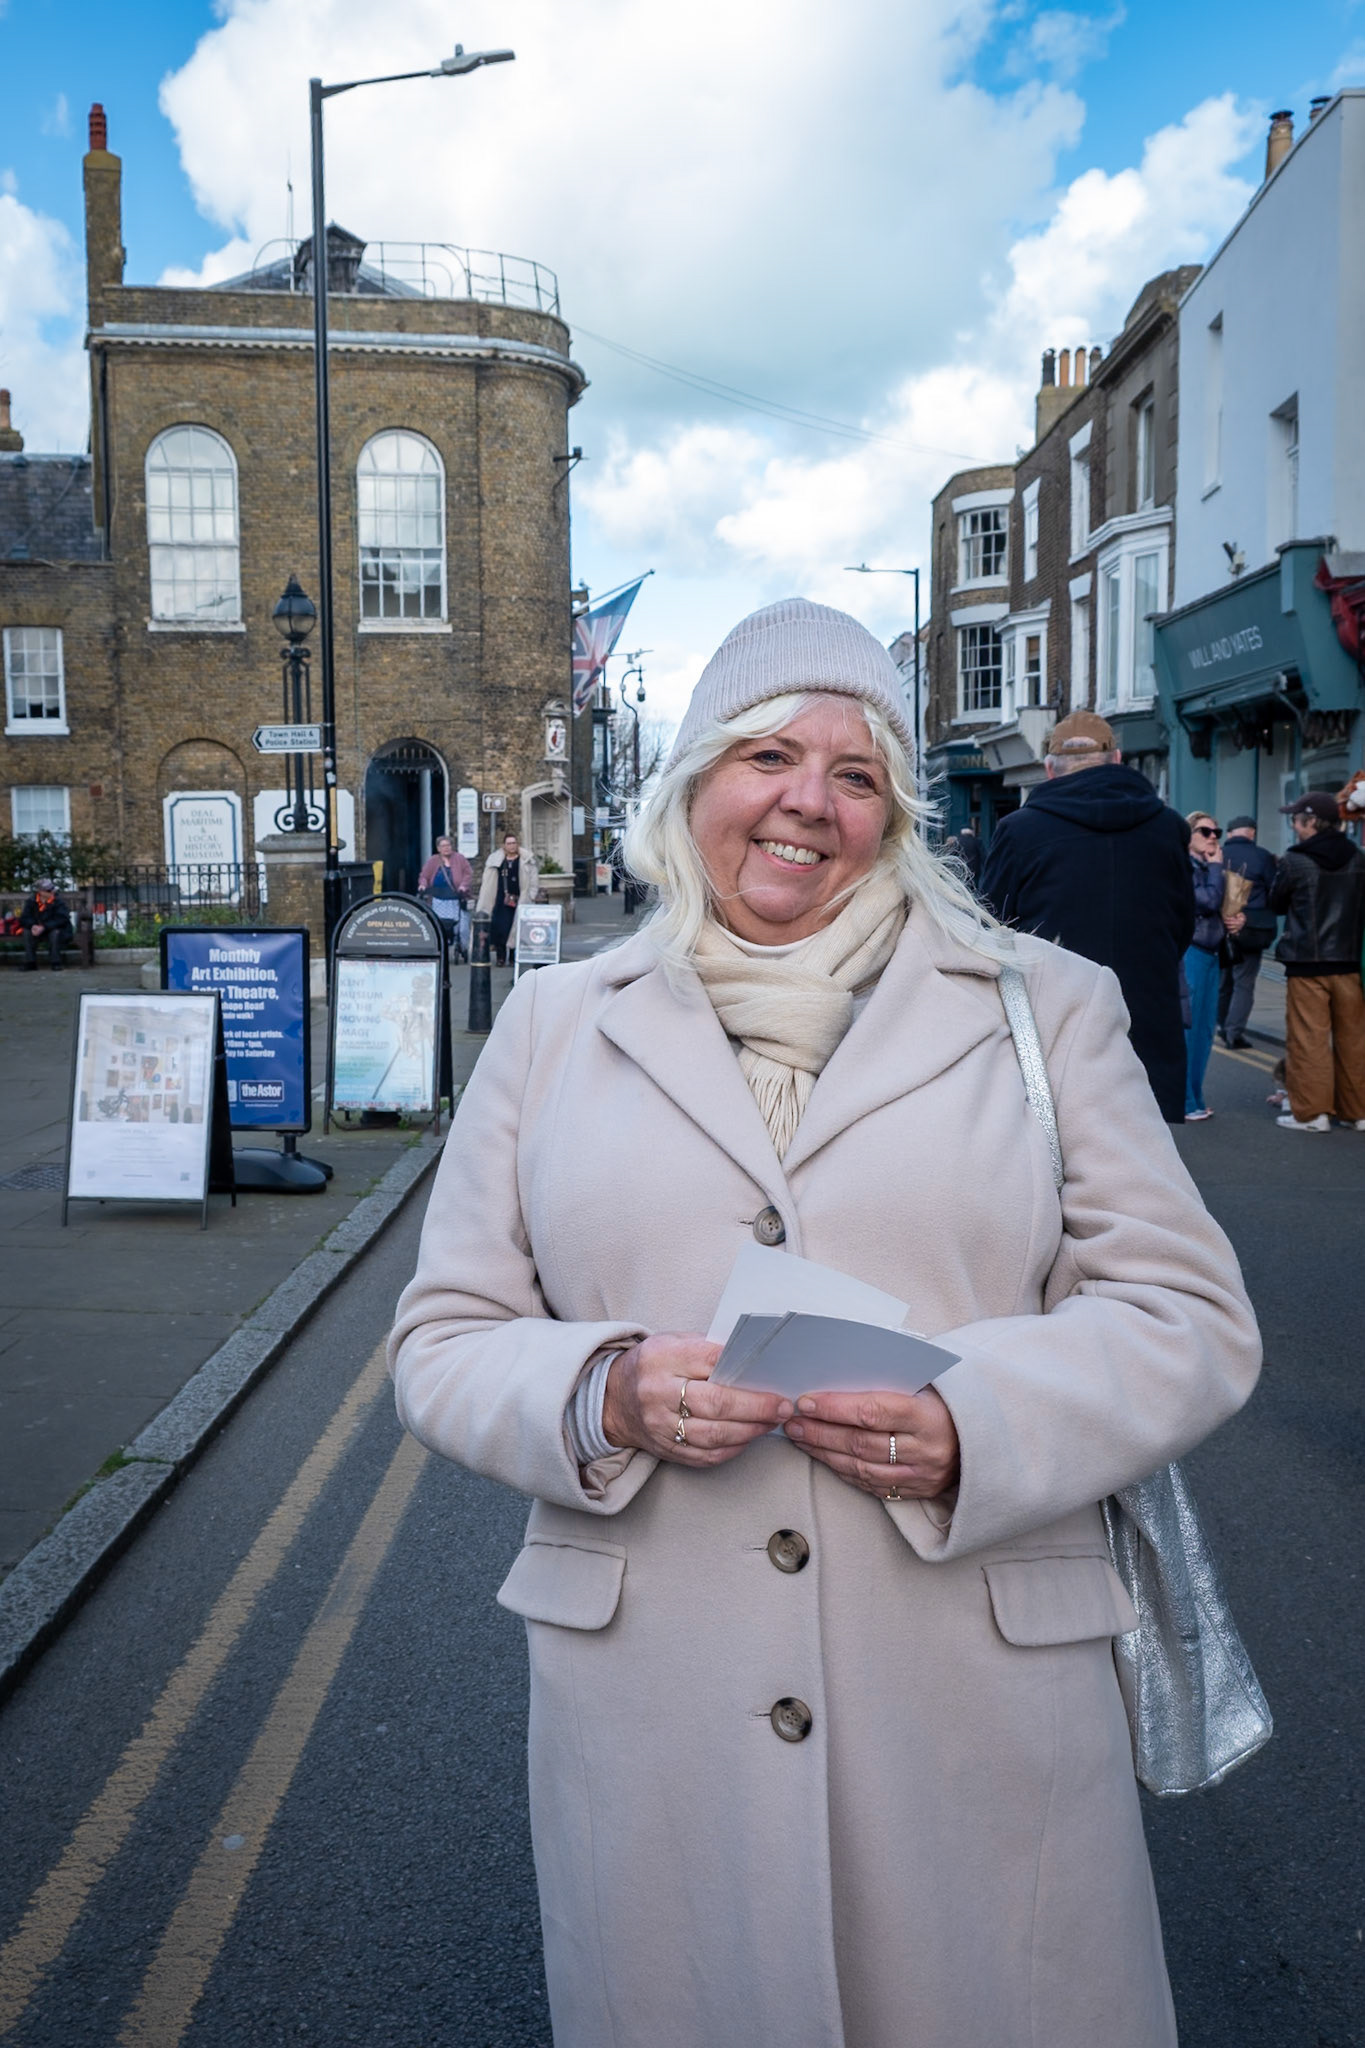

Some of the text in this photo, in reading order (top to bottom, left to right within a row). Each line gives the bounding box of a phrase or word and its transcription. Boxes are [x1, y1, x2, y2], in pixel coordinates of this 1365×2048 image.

[1188, 625, 1263, 669] WILL AND YATES
[265, 739, 288, 747] Police
[191, 809, 215, 818] DEAL
[180, 817, 224, 826] MARITIME
[188, 834, 217, 842] LOCAL
[185, 843, 222, 851] HISTORY
[183, 851, 224, 859] MUSEUM
[356, 908, 379, 925] MUSEUM
[378, 905, 388, 913] OF
[387, 905, 400, 913] THE
[399, 908, 422, 926] MOVING
[367, 920, 411, 929] OPEN ALL YEAR
[209, 948, 262, 964] Monthly
[191, 966, 279, 982] Art Exhibition,
[341, 978, 366, 987] KENT
[226, 985, 280, 1001] Theatre,
[340, 991, 384, 1000] MUSEUM
[244, 1001, 265, 1011] Road
[339, 1002, 373, 1012] OF THE
[338, 1015, 382, 1025] MOVING
[234, 1030, 242, 1039] of
[242, 1030, 260, 1039] local
[337, 1028, 371, 1038] IMAGE
[237, 1049, 245, 1058] to
[244, 1049, 276, 1058] Saturday
[241, 1084, 282, 1097] the Astor
